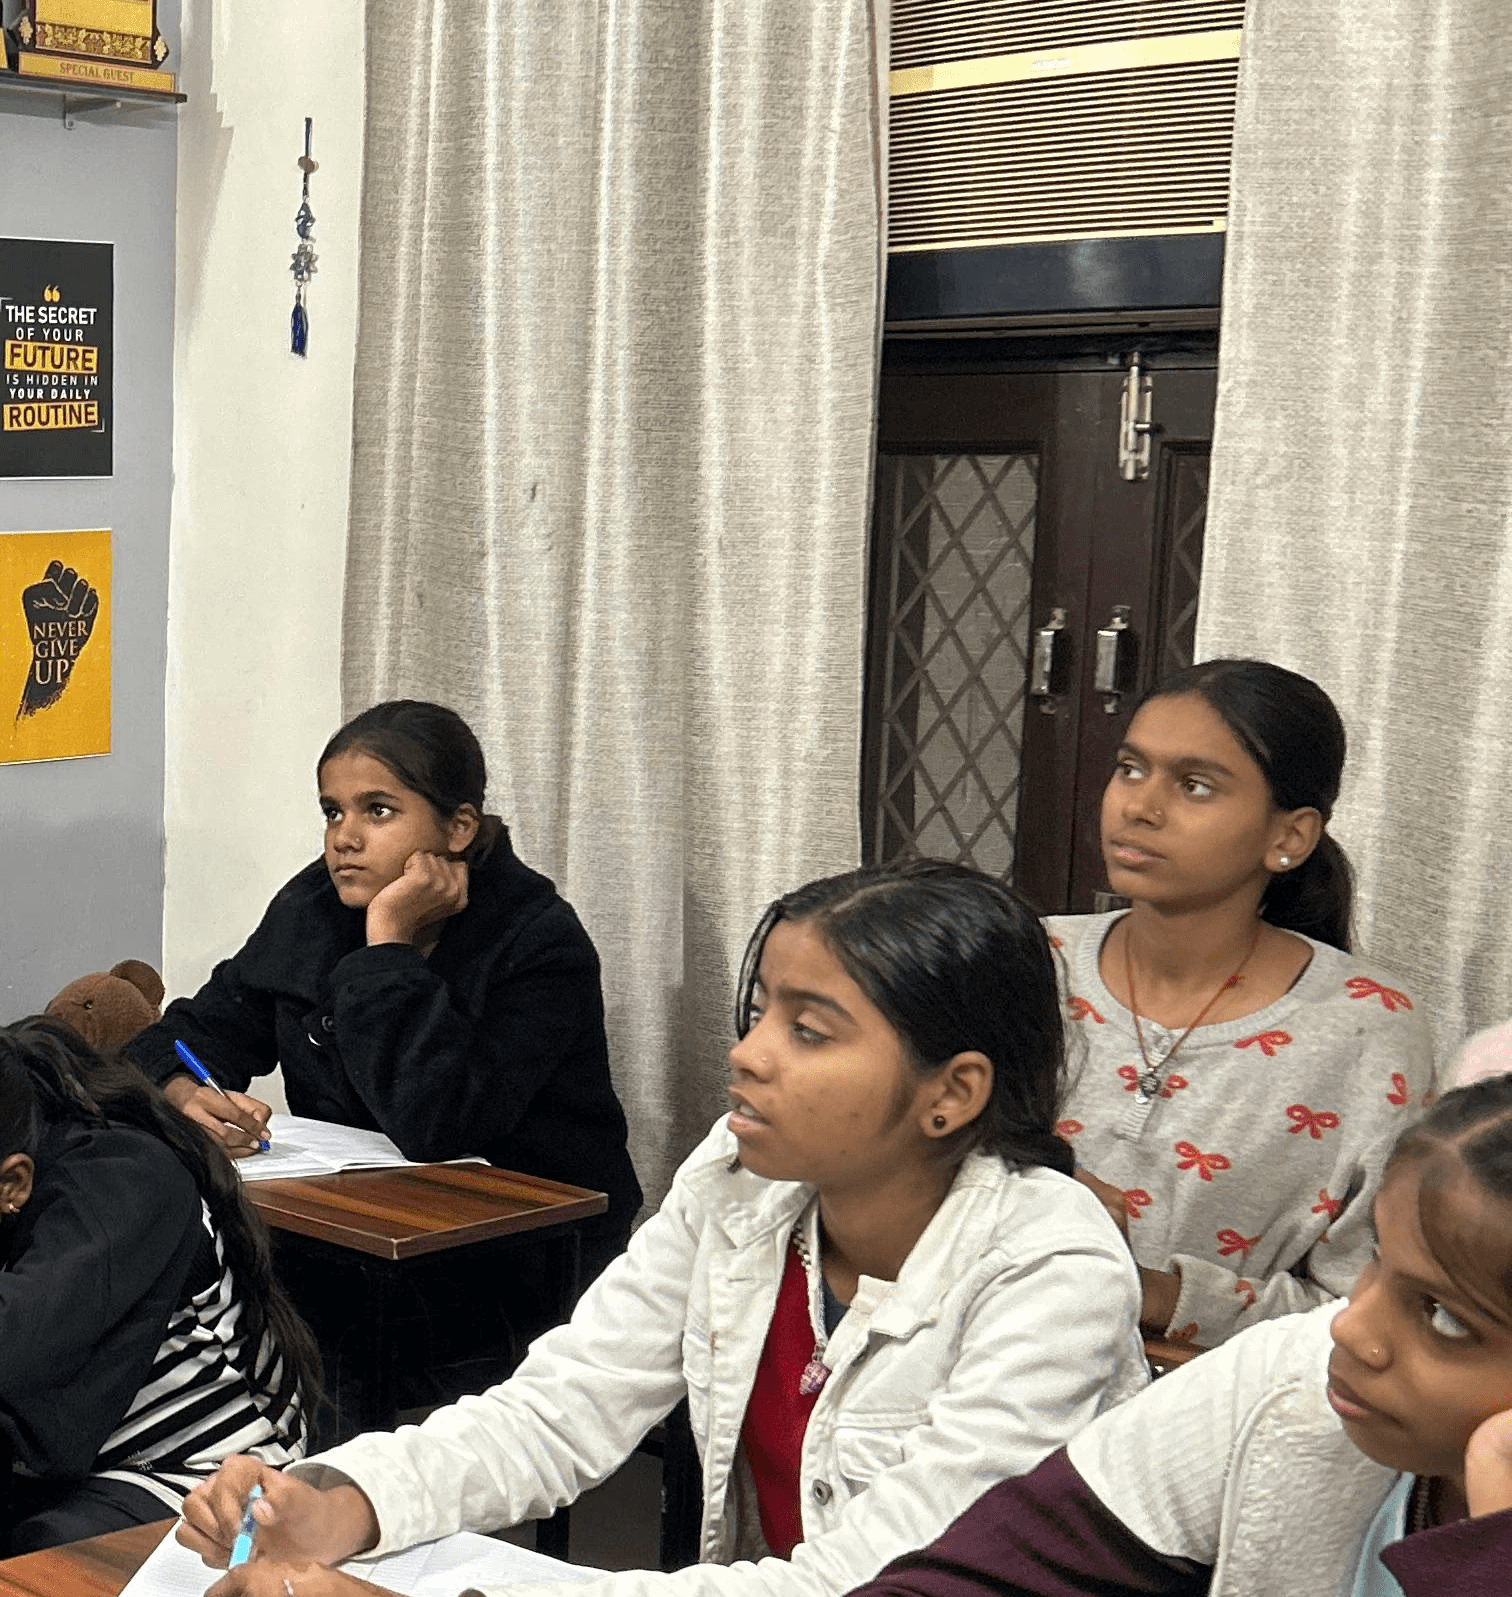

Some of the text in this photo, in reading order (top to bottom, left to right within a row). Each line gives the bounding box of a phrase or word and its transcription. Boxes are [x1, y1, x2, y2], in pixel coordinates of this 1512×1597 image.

[59, 62, 135, 83] SPECIAL GUEST
[6, 305, 97, 325] THE SECRET
[16, 328, 84, 342] OF YOUR
[10, 344, 94, 371] FUTURE
[6, 374, 98, 387] IS HIDDEN IN
[9, 388, 91, 400] YOUR DAILY
[9, 403, 96, 428] ROUTINE
[33, 620, 89, 639] NEVER
[35, 638, 79, 658] GIVE
